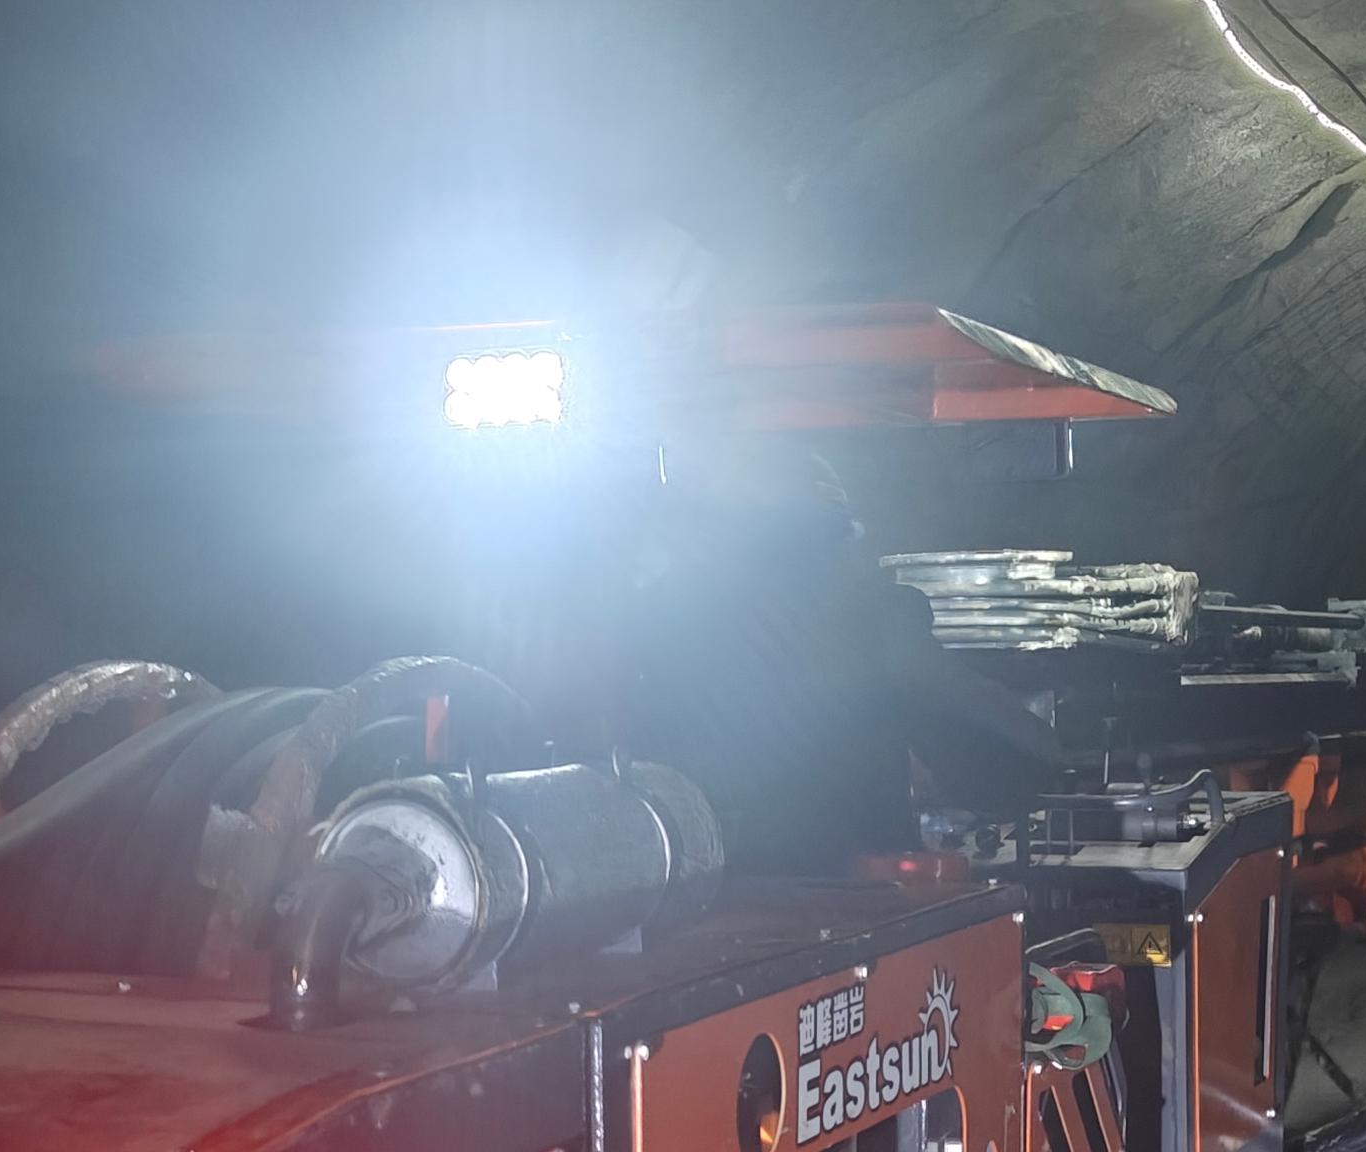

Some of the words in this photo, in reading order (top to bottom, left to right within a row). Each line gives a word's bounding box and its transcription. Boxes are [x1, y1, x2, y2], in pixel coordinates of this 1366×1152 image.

[799, 986, 865, 1057] 迪峰凿岩
[797, 1030, 950, 1144] Eastsun
